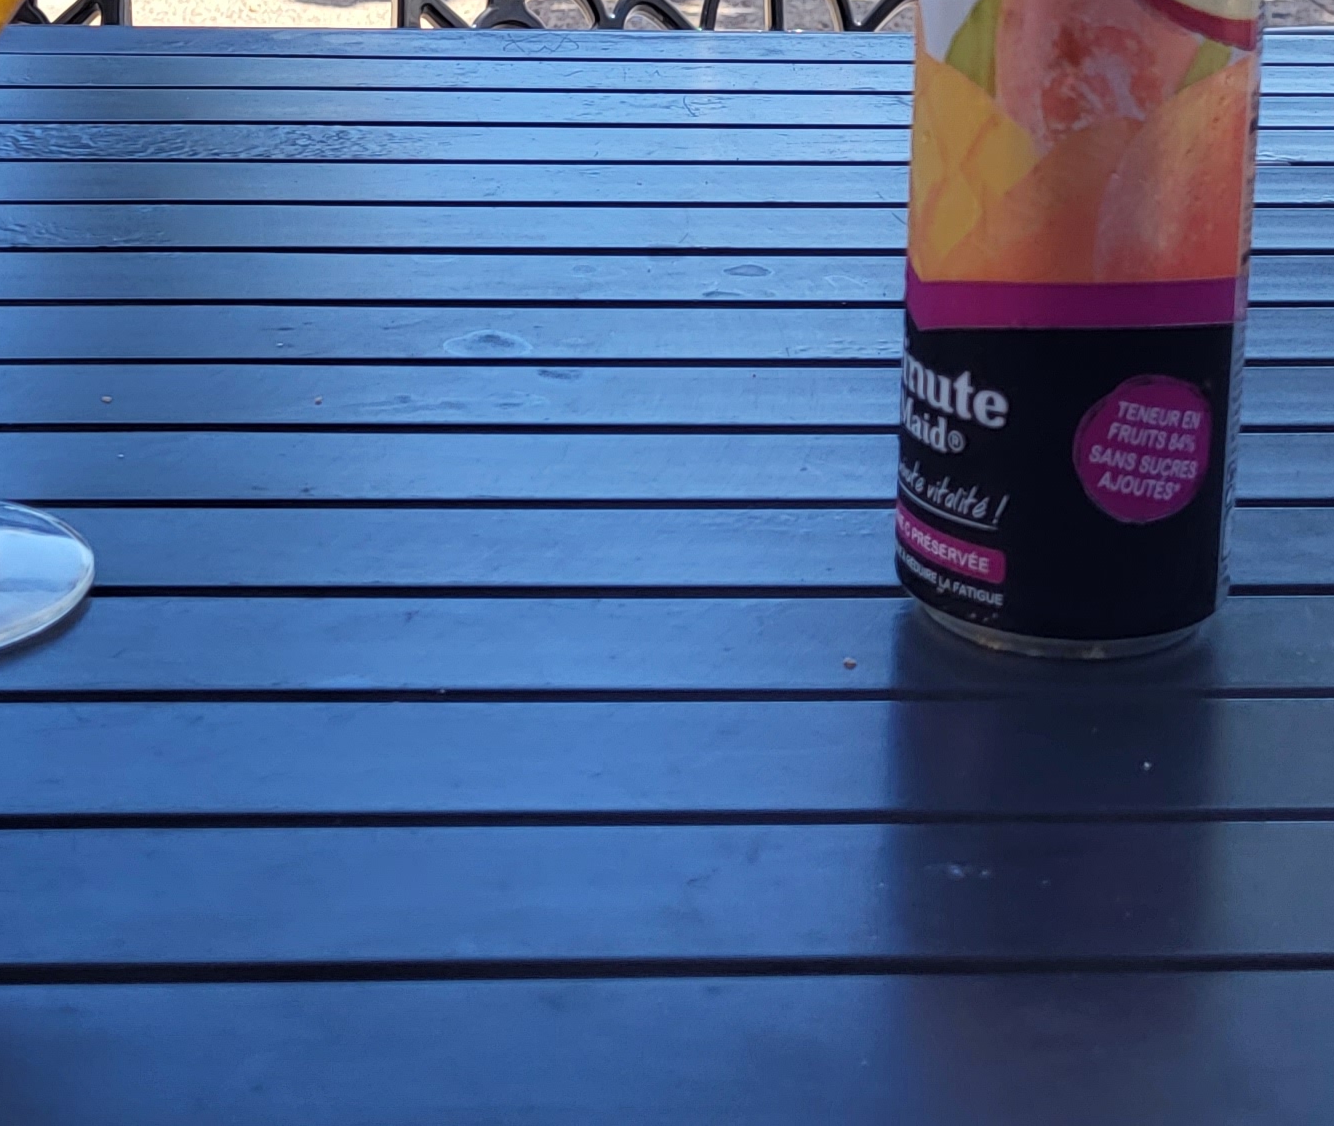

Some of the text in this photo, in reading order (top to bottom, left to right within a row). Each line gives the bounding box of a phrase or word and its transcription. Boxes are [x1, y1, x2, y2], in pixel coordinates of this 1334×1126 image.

[1118, 400, 1202, 430] TENEUR EN
[1107, 421, 1168, 450] FRUITS
[1088, 444, 1199, 480] SANS SUCRES
[953, 581, 1005, 606] FATIGUE
